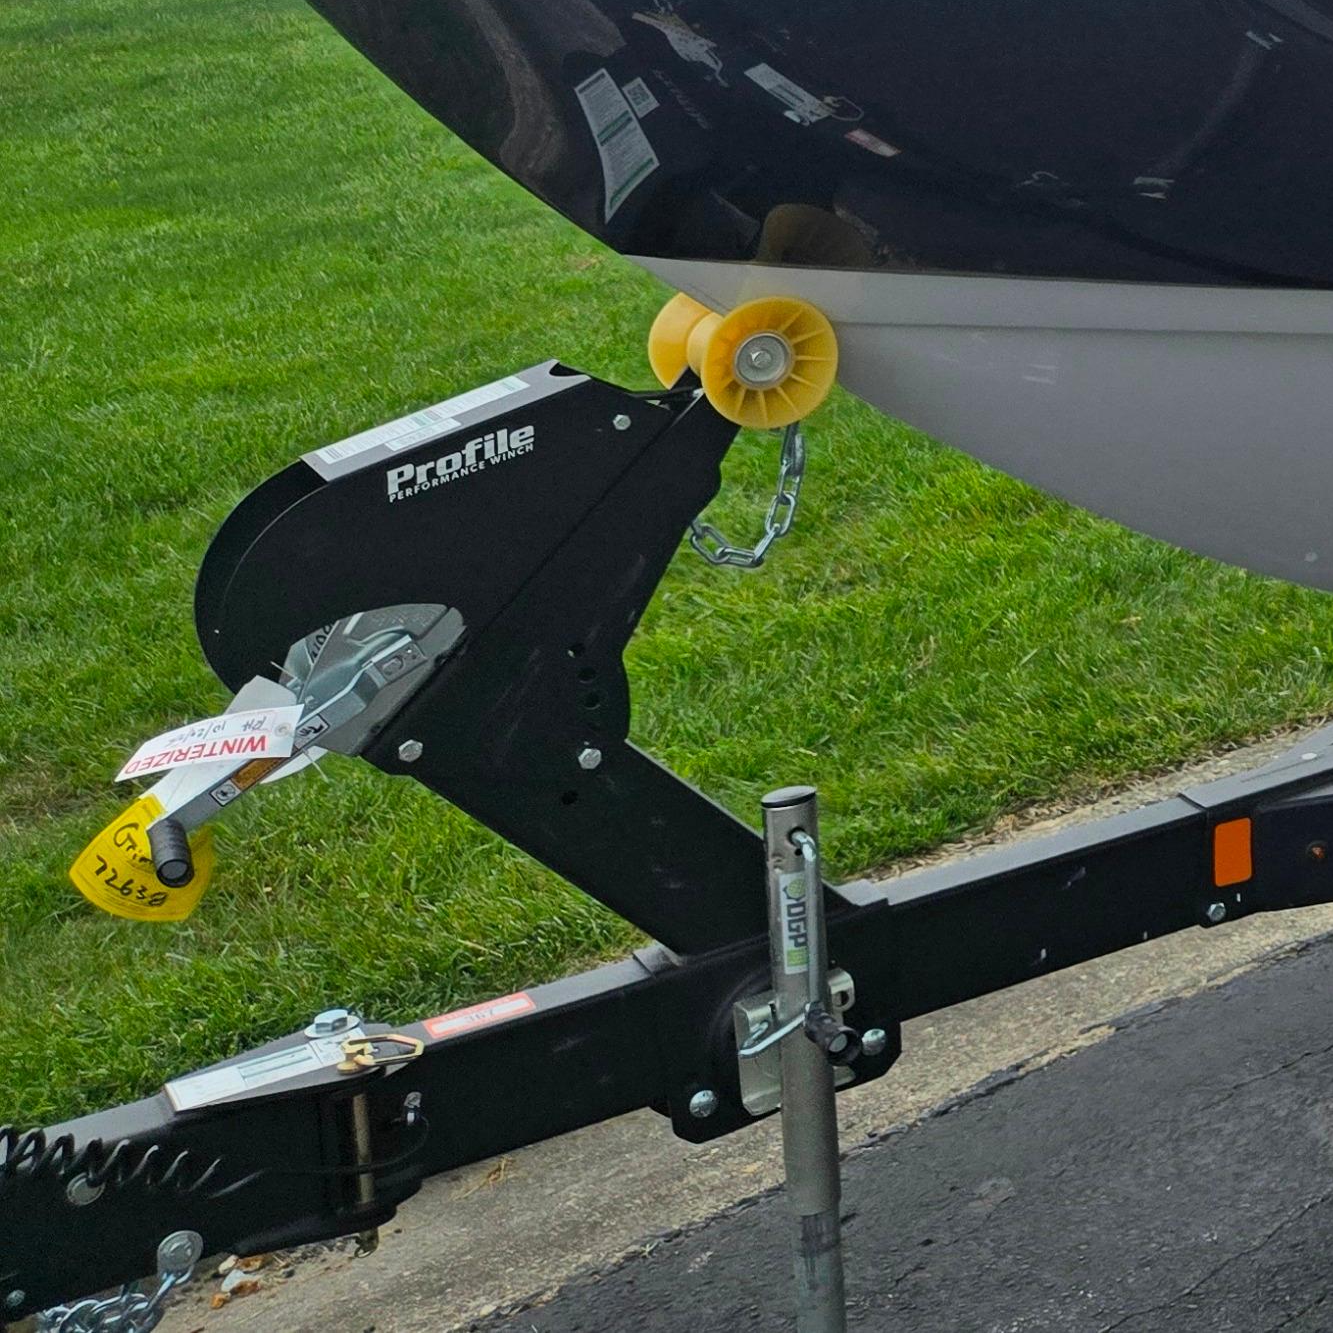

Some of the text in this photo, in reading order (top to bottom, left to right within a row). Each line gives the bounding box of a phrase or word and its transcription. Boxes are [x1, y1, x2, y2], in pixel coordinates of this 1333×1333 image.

[386, 425, 535, 495] Profile
[389, 443, 534, 503] PERFORMANCE WINCH
[125, 735, 266, 774] WINTERIZED
